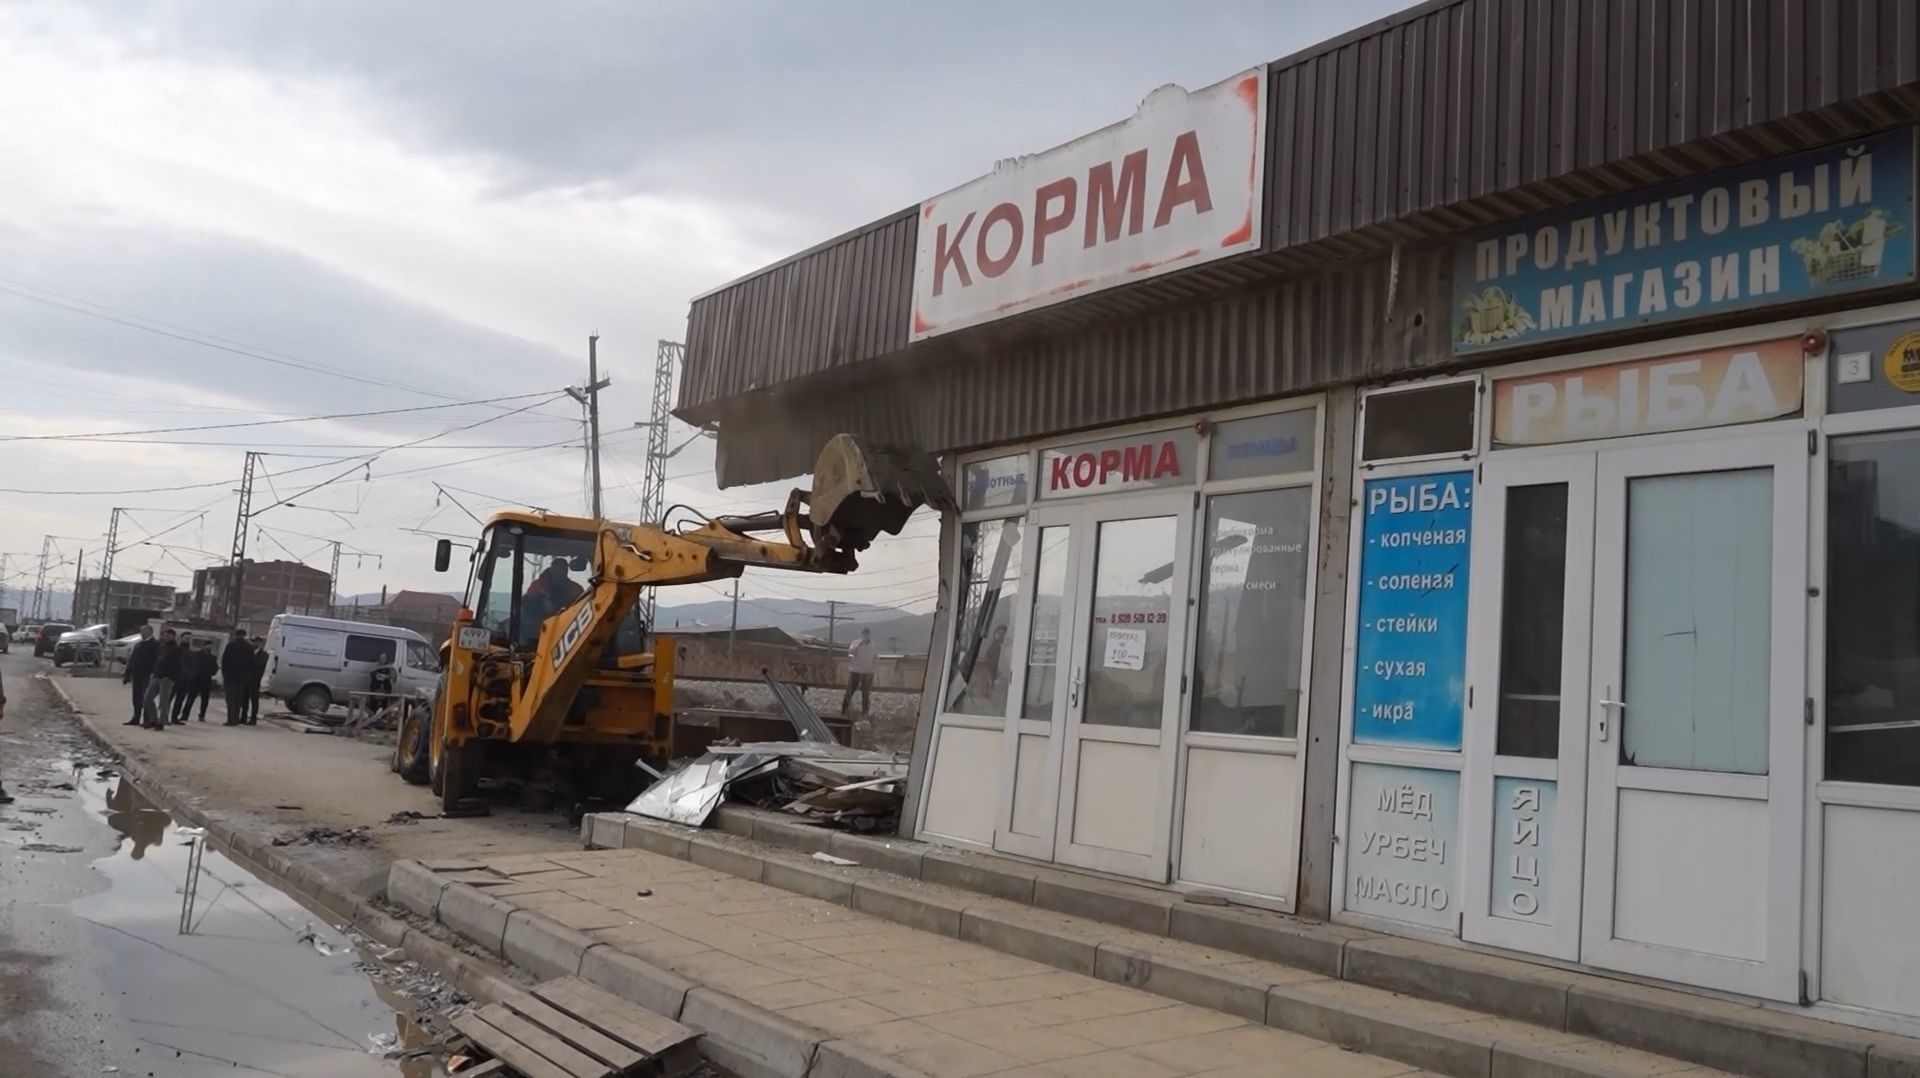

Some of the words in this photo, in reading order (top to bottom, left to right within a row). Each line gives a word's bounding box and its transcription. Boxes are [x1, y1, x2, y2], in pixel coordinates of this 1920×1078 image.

[932, 130, 1213, 297] КОРМА
[1475, 145, 1873, 282] ПРОДУКТОВЫЙ
[1539, 245, 1780, 331] МАГАЗИН
[1848, 359, 1860, 376] 3
[1511, 351, 1776, 442] РЫБА
[1050, 440, 1181, 491] КОРМА
[1369, 481, 1471, 515] РЫБА:
[1380, 528, 1466, 548] копченая
[1378, 572, 1454, 591] соленая
[552, 600, 594, 669] JCB
[1376, 613, 1438, 634] стейки
[1374, 660, 1426, 680] сухая
[1371, 702, 1415, 724] икра
[1376, 784, 1434, 822] МЁД
[1361, 830, 1446, 865] УРБЕЧ
[1511, 786, 1541, 916] ЯЙЦО
[1354, 873, 1449, 912] МАСЛО
